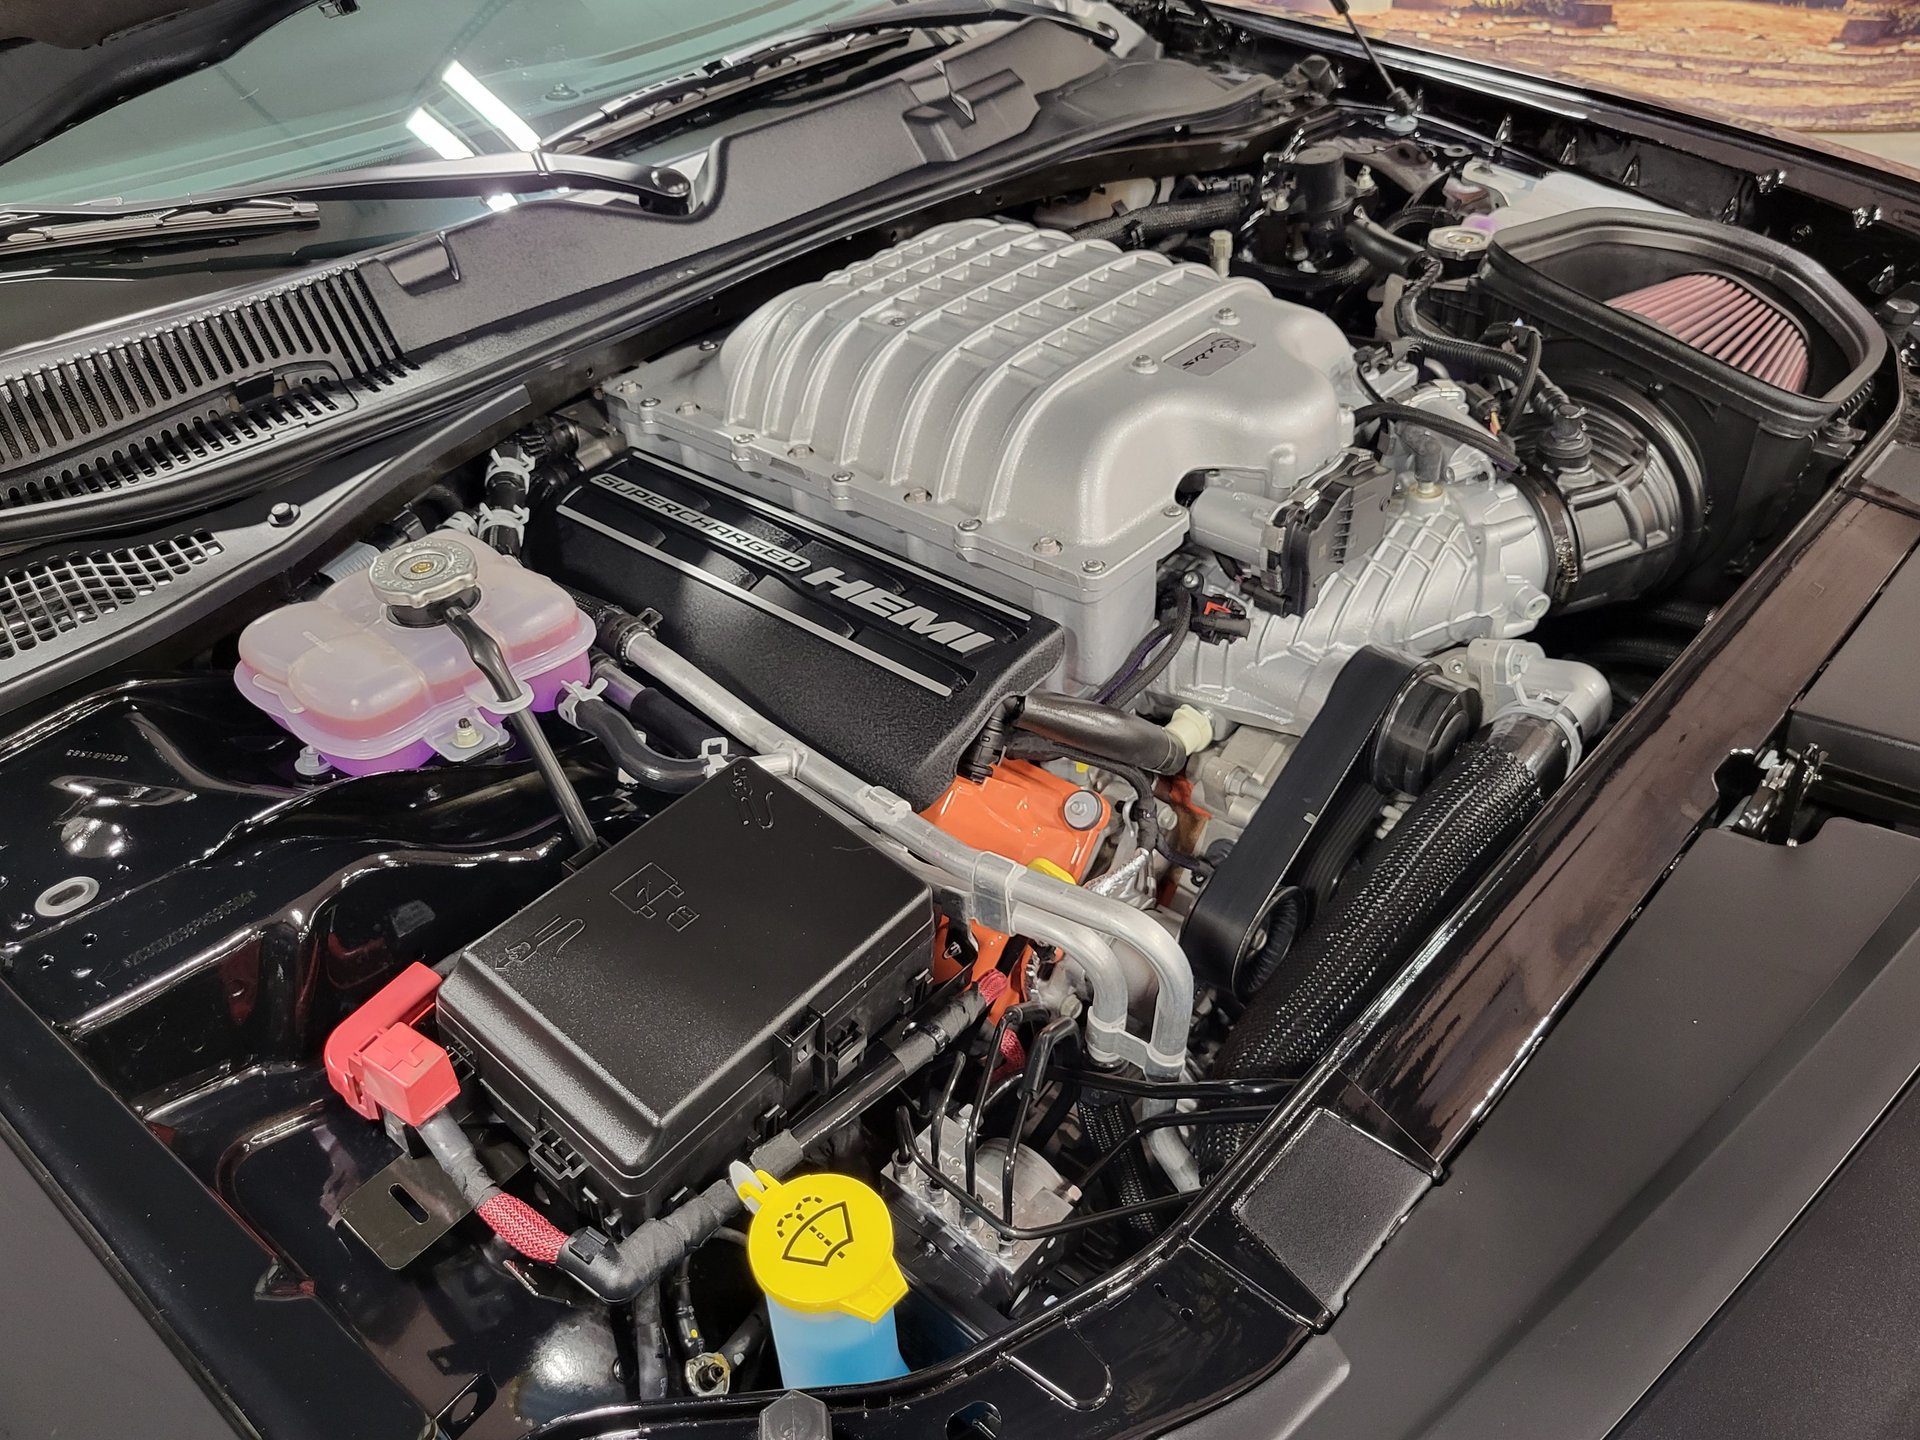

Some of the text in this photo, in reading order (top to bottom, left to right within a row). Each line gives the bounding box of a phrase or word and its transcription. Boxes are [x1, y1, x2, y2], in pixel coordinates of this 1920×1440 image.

[1182, 346, 1216, 370] SRT
[597, 475, 996, 653] SUPERCHARGED HEMI
